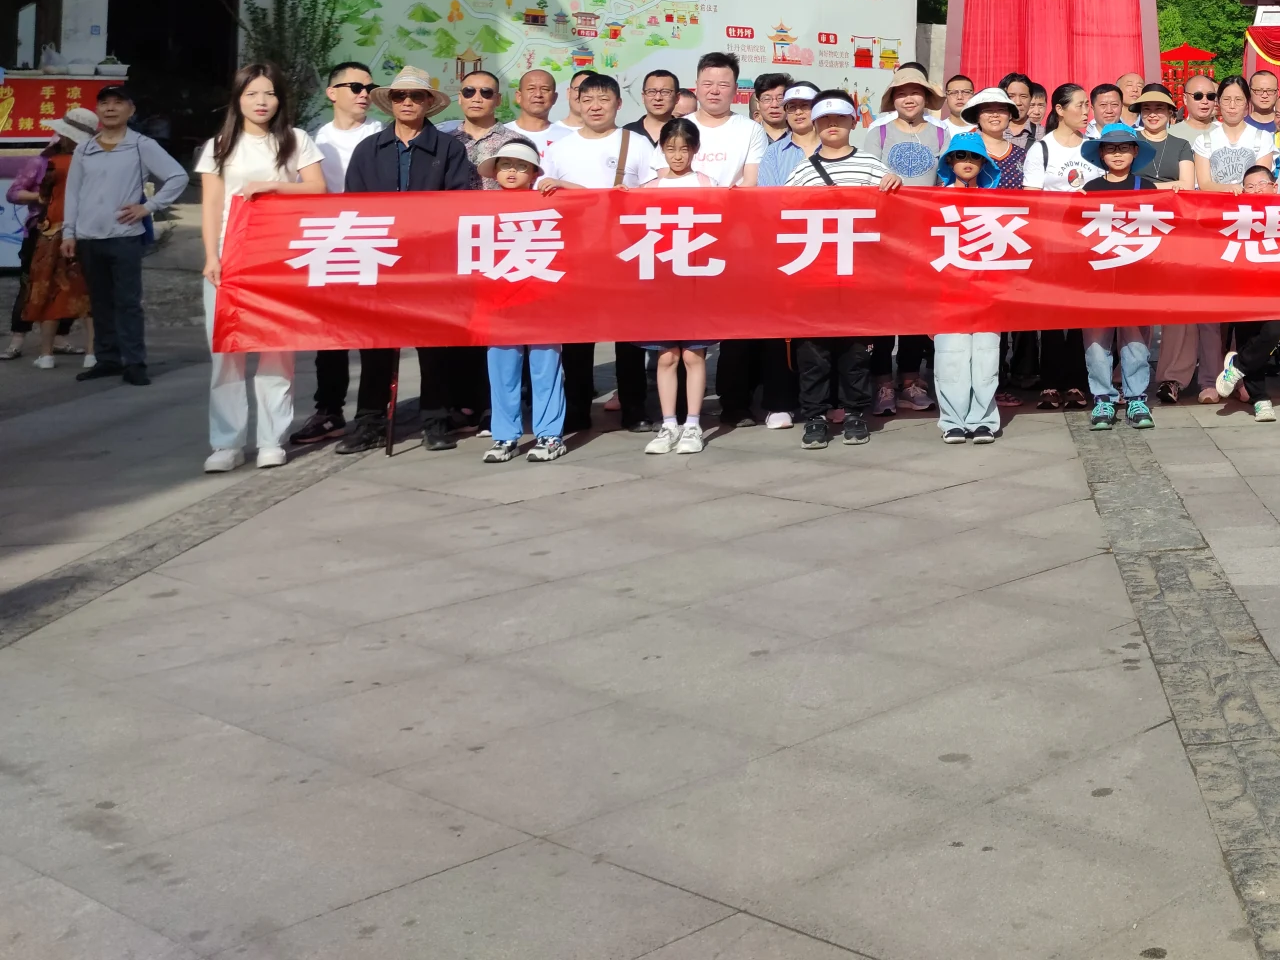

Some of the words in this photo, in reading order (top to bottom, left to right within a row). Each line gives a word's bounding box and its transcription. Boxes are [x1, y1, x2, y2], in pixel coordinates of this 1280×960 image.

[728, 28, 752, 37] 牡丹坪
[697, 151, 727, 162] UCCI
[1221, 156, 1241, 166] YOUR
[1057, 160, 1092, 177] SANDWICH
[1216, 163, 1244, 180] SWING
